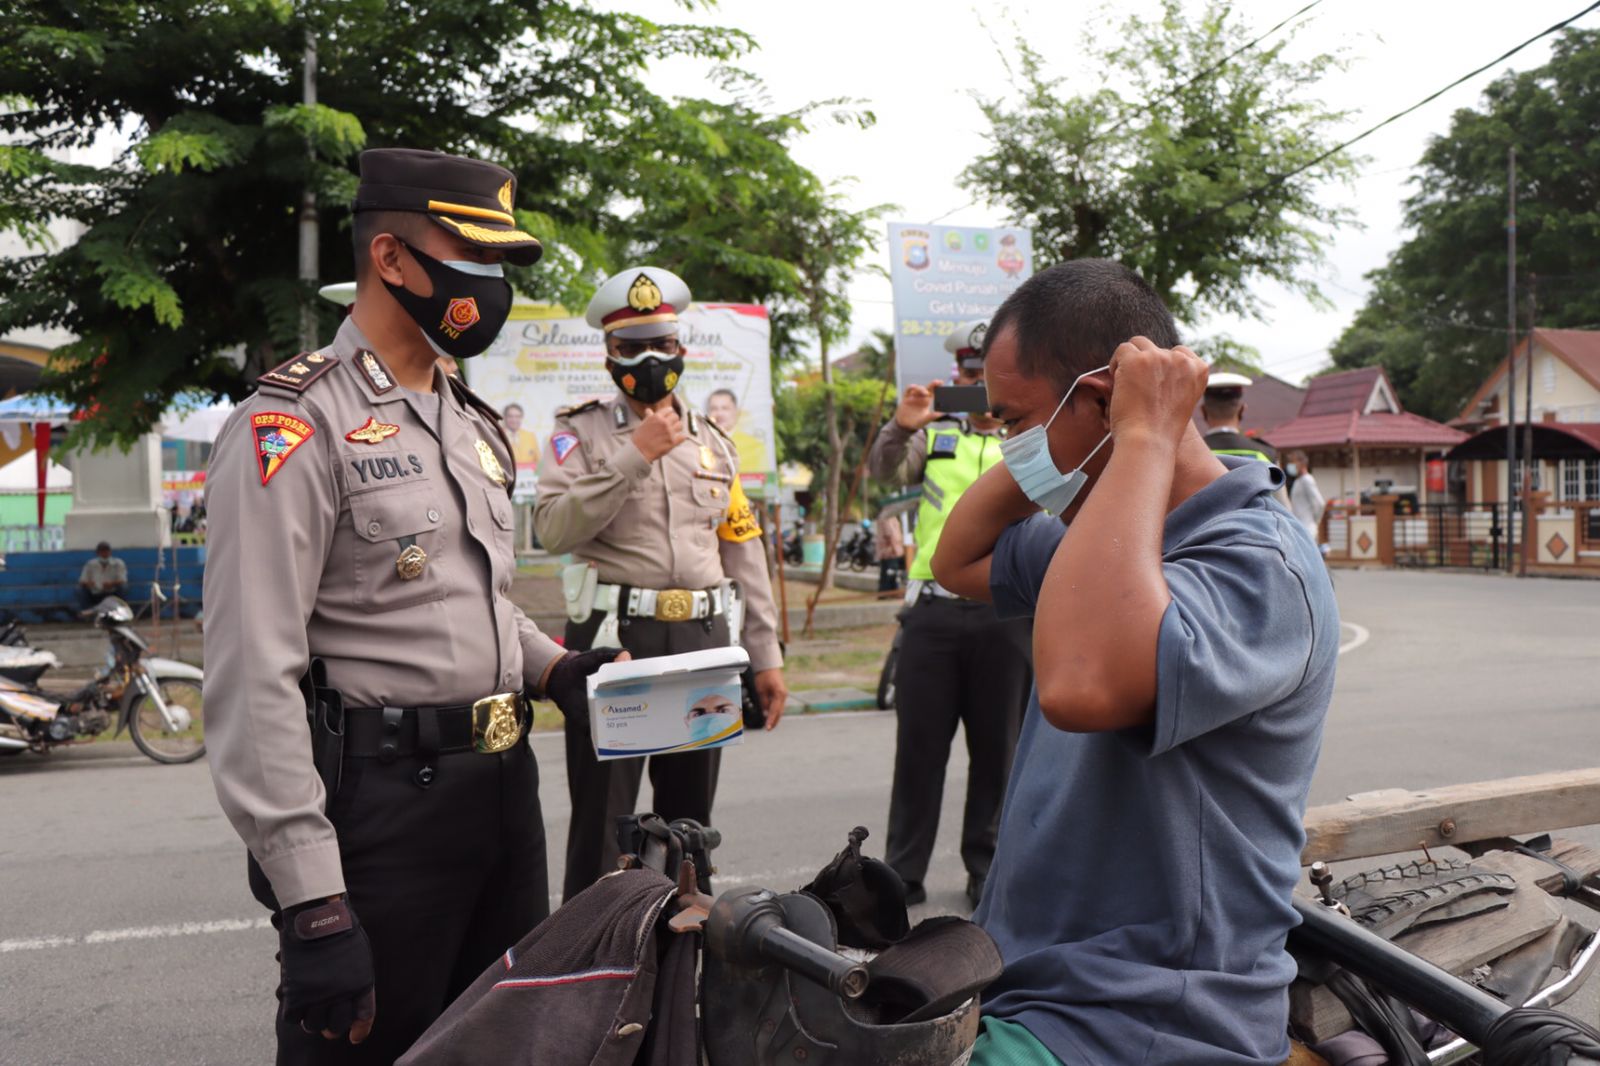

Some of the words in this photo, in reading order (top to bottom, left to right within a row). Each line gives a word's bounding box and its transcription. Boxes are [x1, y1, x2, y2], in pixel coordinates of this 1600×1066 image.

[913, 279, 953, 293] Covid
[929, 299, 954, 315] Get
[439, 320, 460, 340] TNI
[521, 323, 605, 346] Selama
[682, 323, 723, 346] ukses
[255, 414, 275, 425] OPS
[277, 415, 311, 436] POLRI
[351, 457, 409, 483] YUDI.
[407, 454, 423, 474] S
[727, 505, 751, 526] KAS
[734, 521, 757, 537] BA
[608, 704, 642, 714] Aksamed
[310, 914, 340, 929] EIGER
